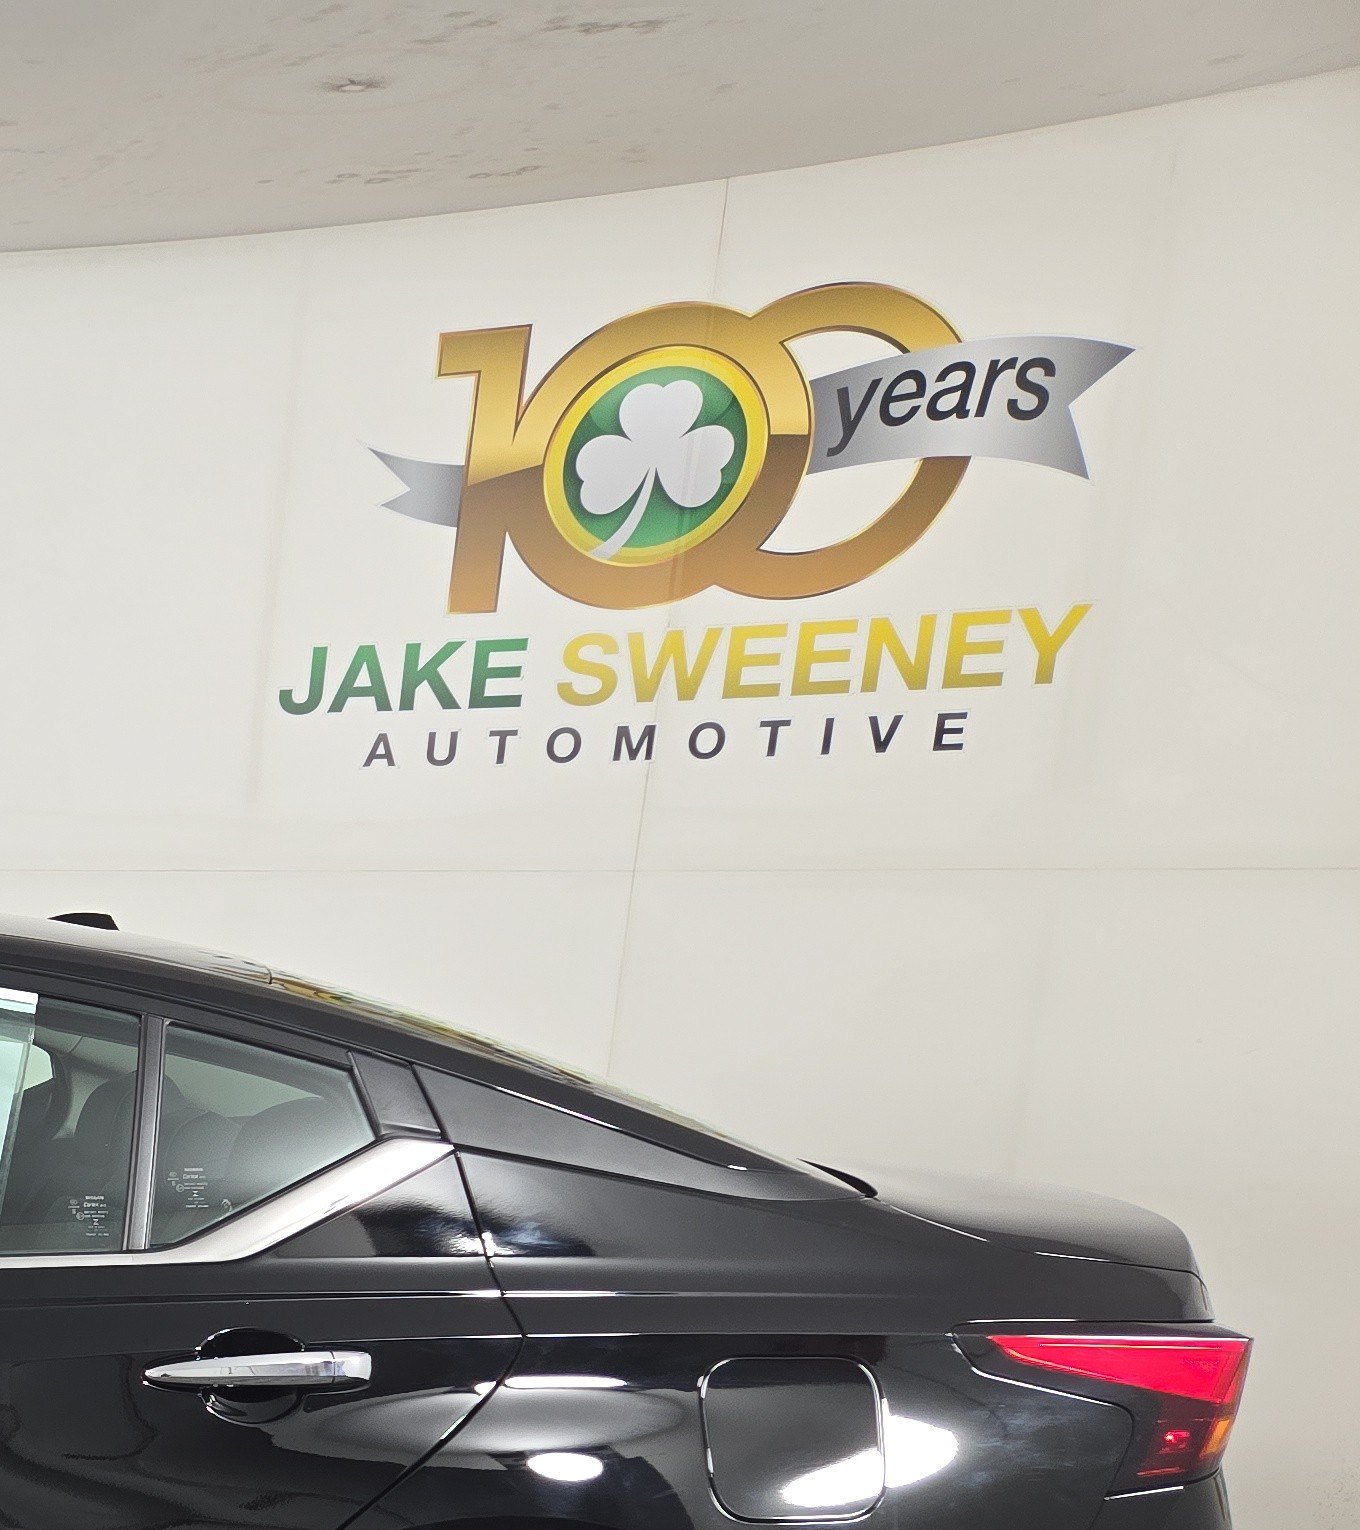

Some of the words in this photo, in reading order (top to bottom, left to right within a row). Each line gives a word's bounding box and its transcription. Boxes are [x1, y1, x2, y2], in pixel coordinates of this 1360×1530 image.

[826, 349, 1057, 457] years
[280, 636, 529, 717] JAKE
[557, 603, 1094, 707] SWEENEY
[363, 711, 970, 768] AUTOMOTIVE
